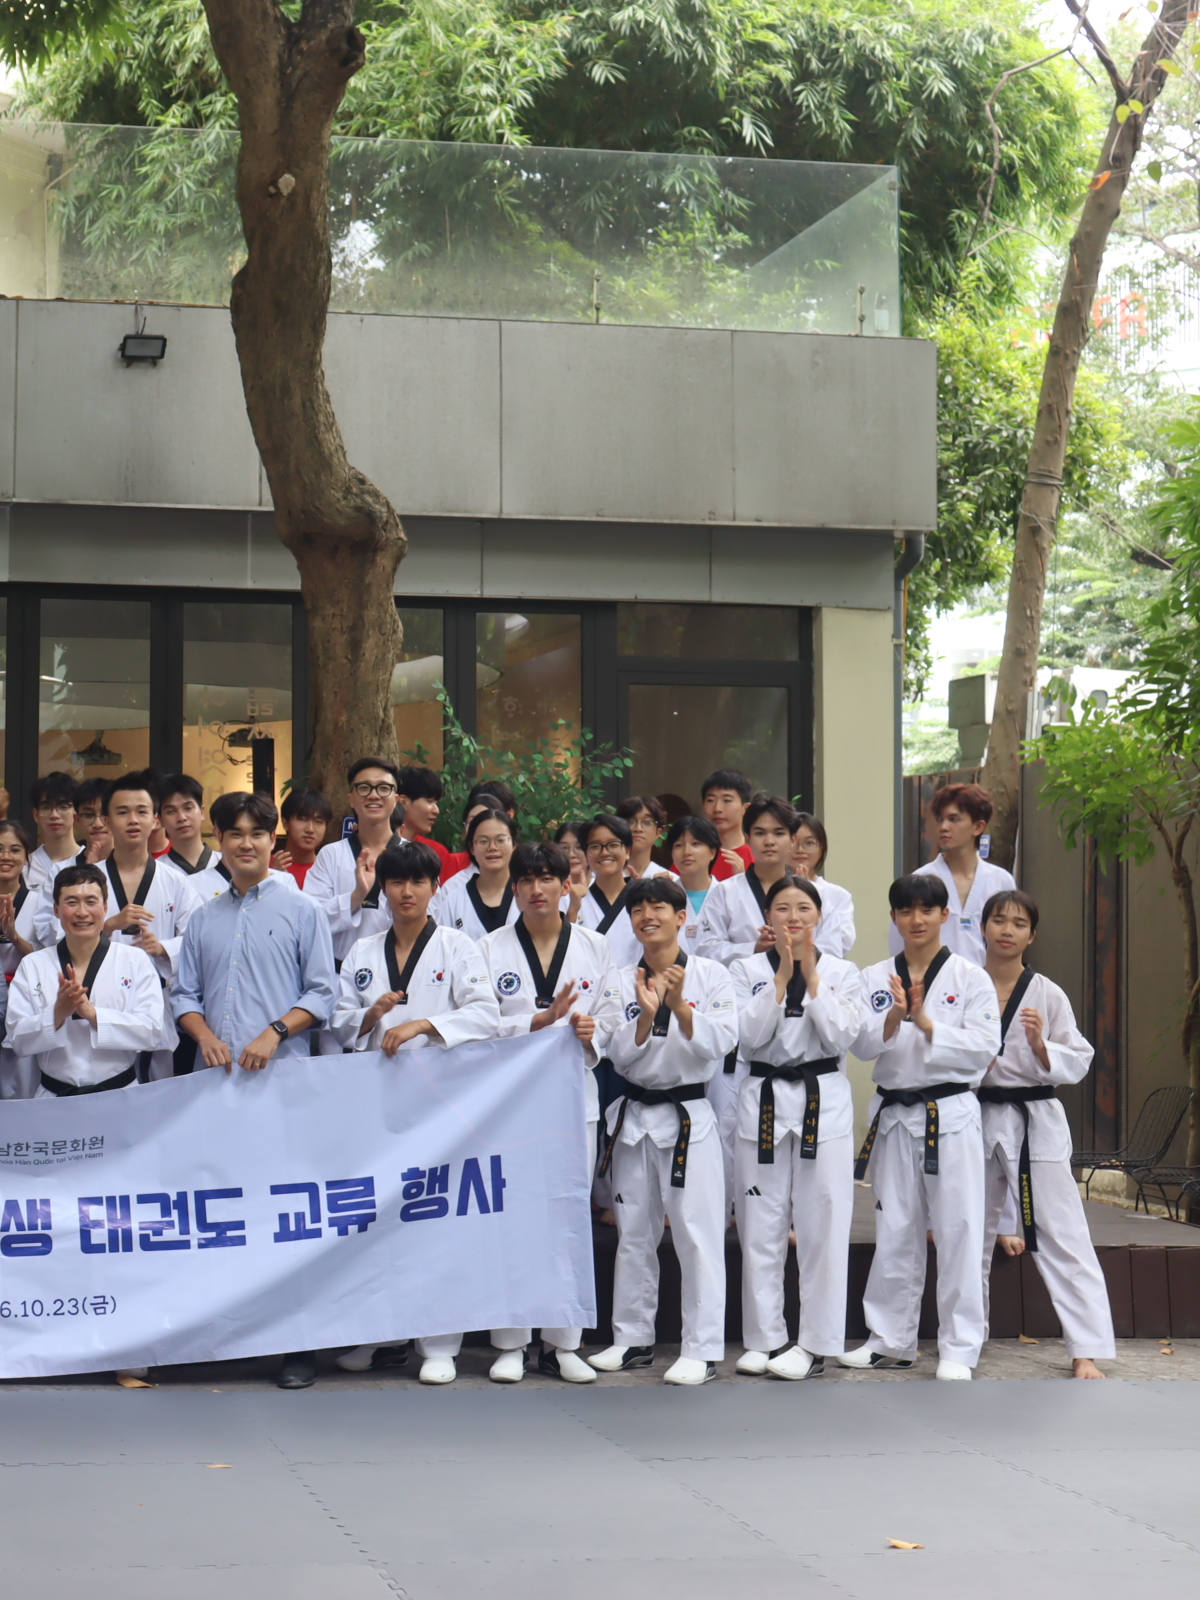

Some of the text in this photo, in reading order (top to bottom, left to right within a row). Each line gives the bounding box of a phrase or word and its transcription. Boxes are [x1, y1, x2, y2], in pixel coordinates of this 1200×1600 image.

[79, 1188, 246, 1254] 태권도
[270, 1176, 376, 1243] 교류
[400, 1155, 506, 1222] 행사
[1021, 1174, 1031, 1226] TAEKWONDO
